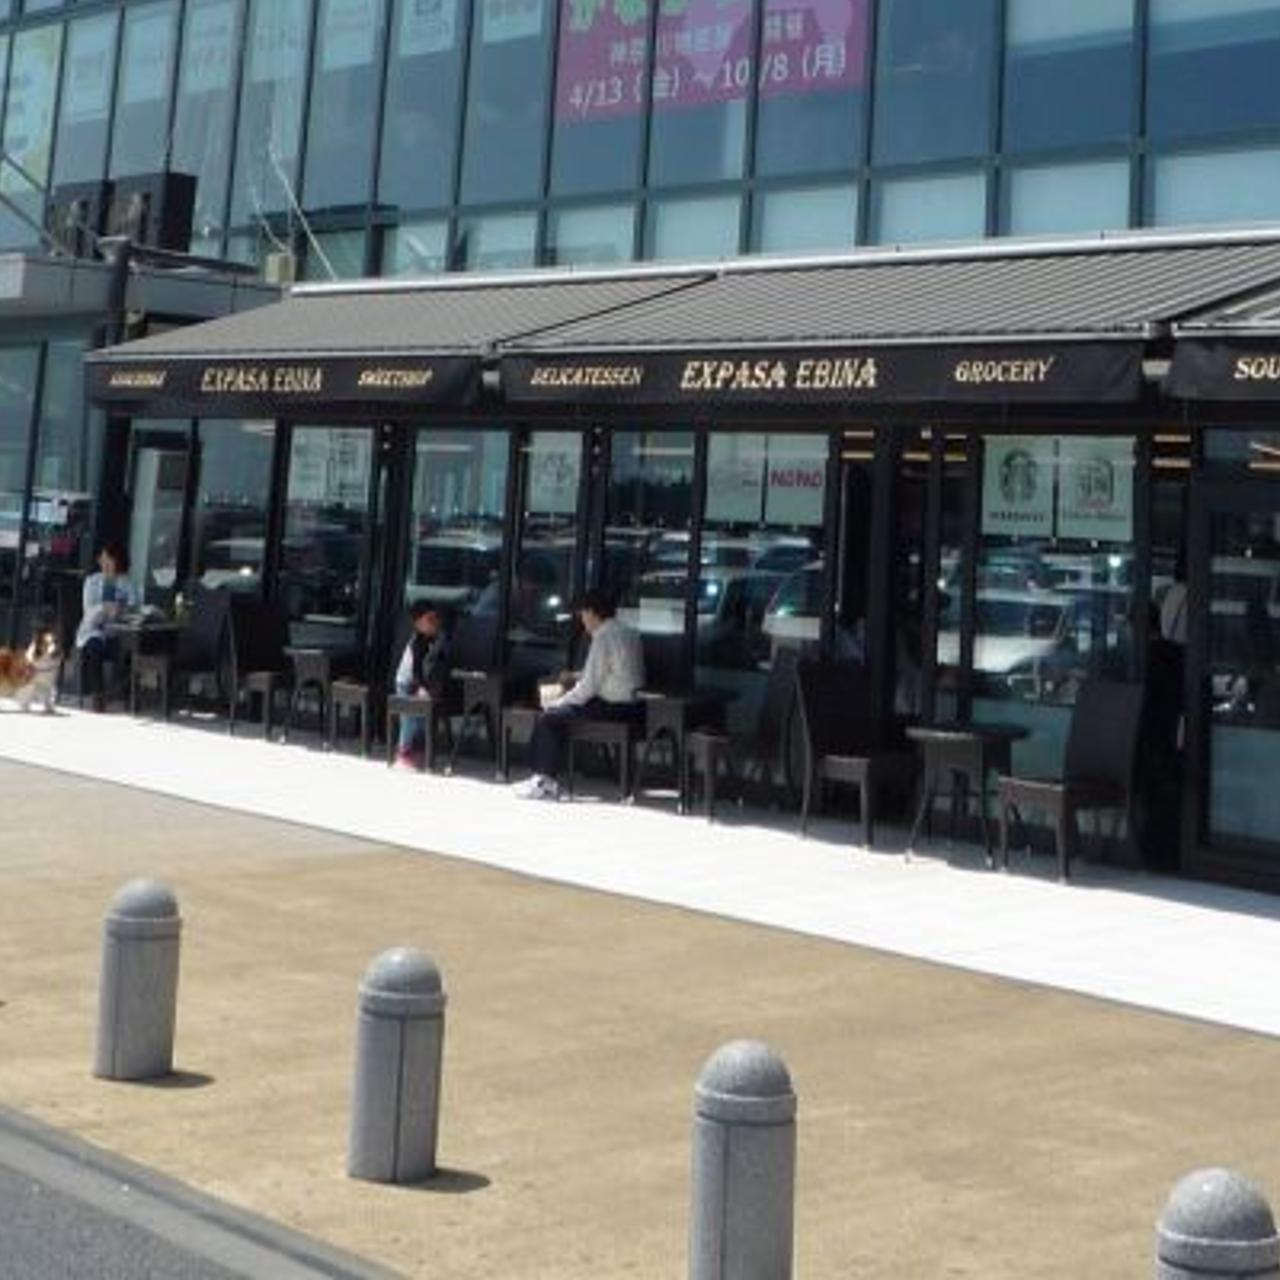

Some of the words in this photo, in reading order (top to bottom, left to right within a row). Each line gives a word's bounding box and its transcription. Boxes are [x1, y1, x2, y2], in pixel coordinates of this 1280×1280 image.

[530, 366, 644, 386] DELICATESSEN
[680, 360, 787, 389] EXPASA
[794, 357, 878, 389] EBINA
[954, 357, 1054, 383] GROCERY
